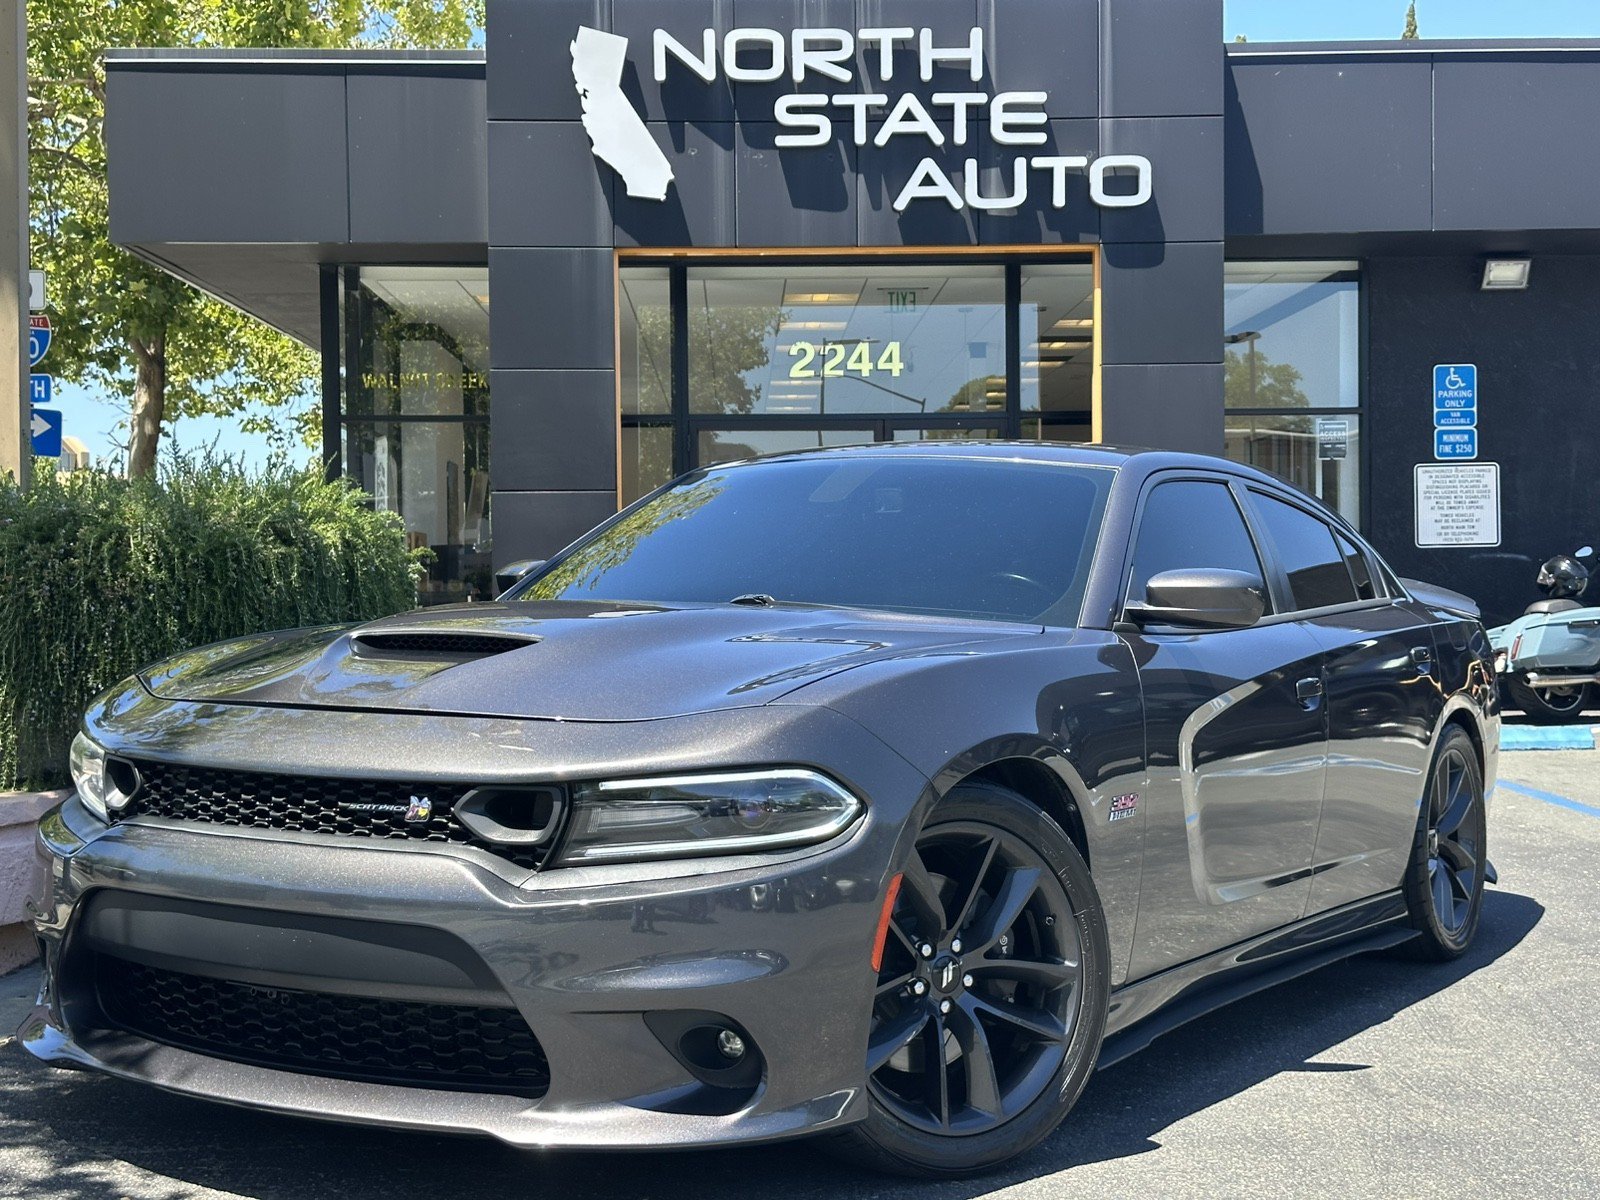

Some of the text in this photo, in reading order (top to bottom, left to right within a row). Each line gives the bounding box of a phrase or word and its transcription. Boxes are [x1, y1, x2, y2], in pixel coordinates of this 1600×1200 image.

[652, 26, 984, 83] NORTH
[774, 91, 1048, 147] STATE
[893, 154, 1153, 211] AUTO
[788, 341, 905, 378] 2244
[1438, 390, 1473, 398] PARKING
[1439, 444, 1472, 453] FINE $250
[1442, 434, 1469, 442] MINIMUM
